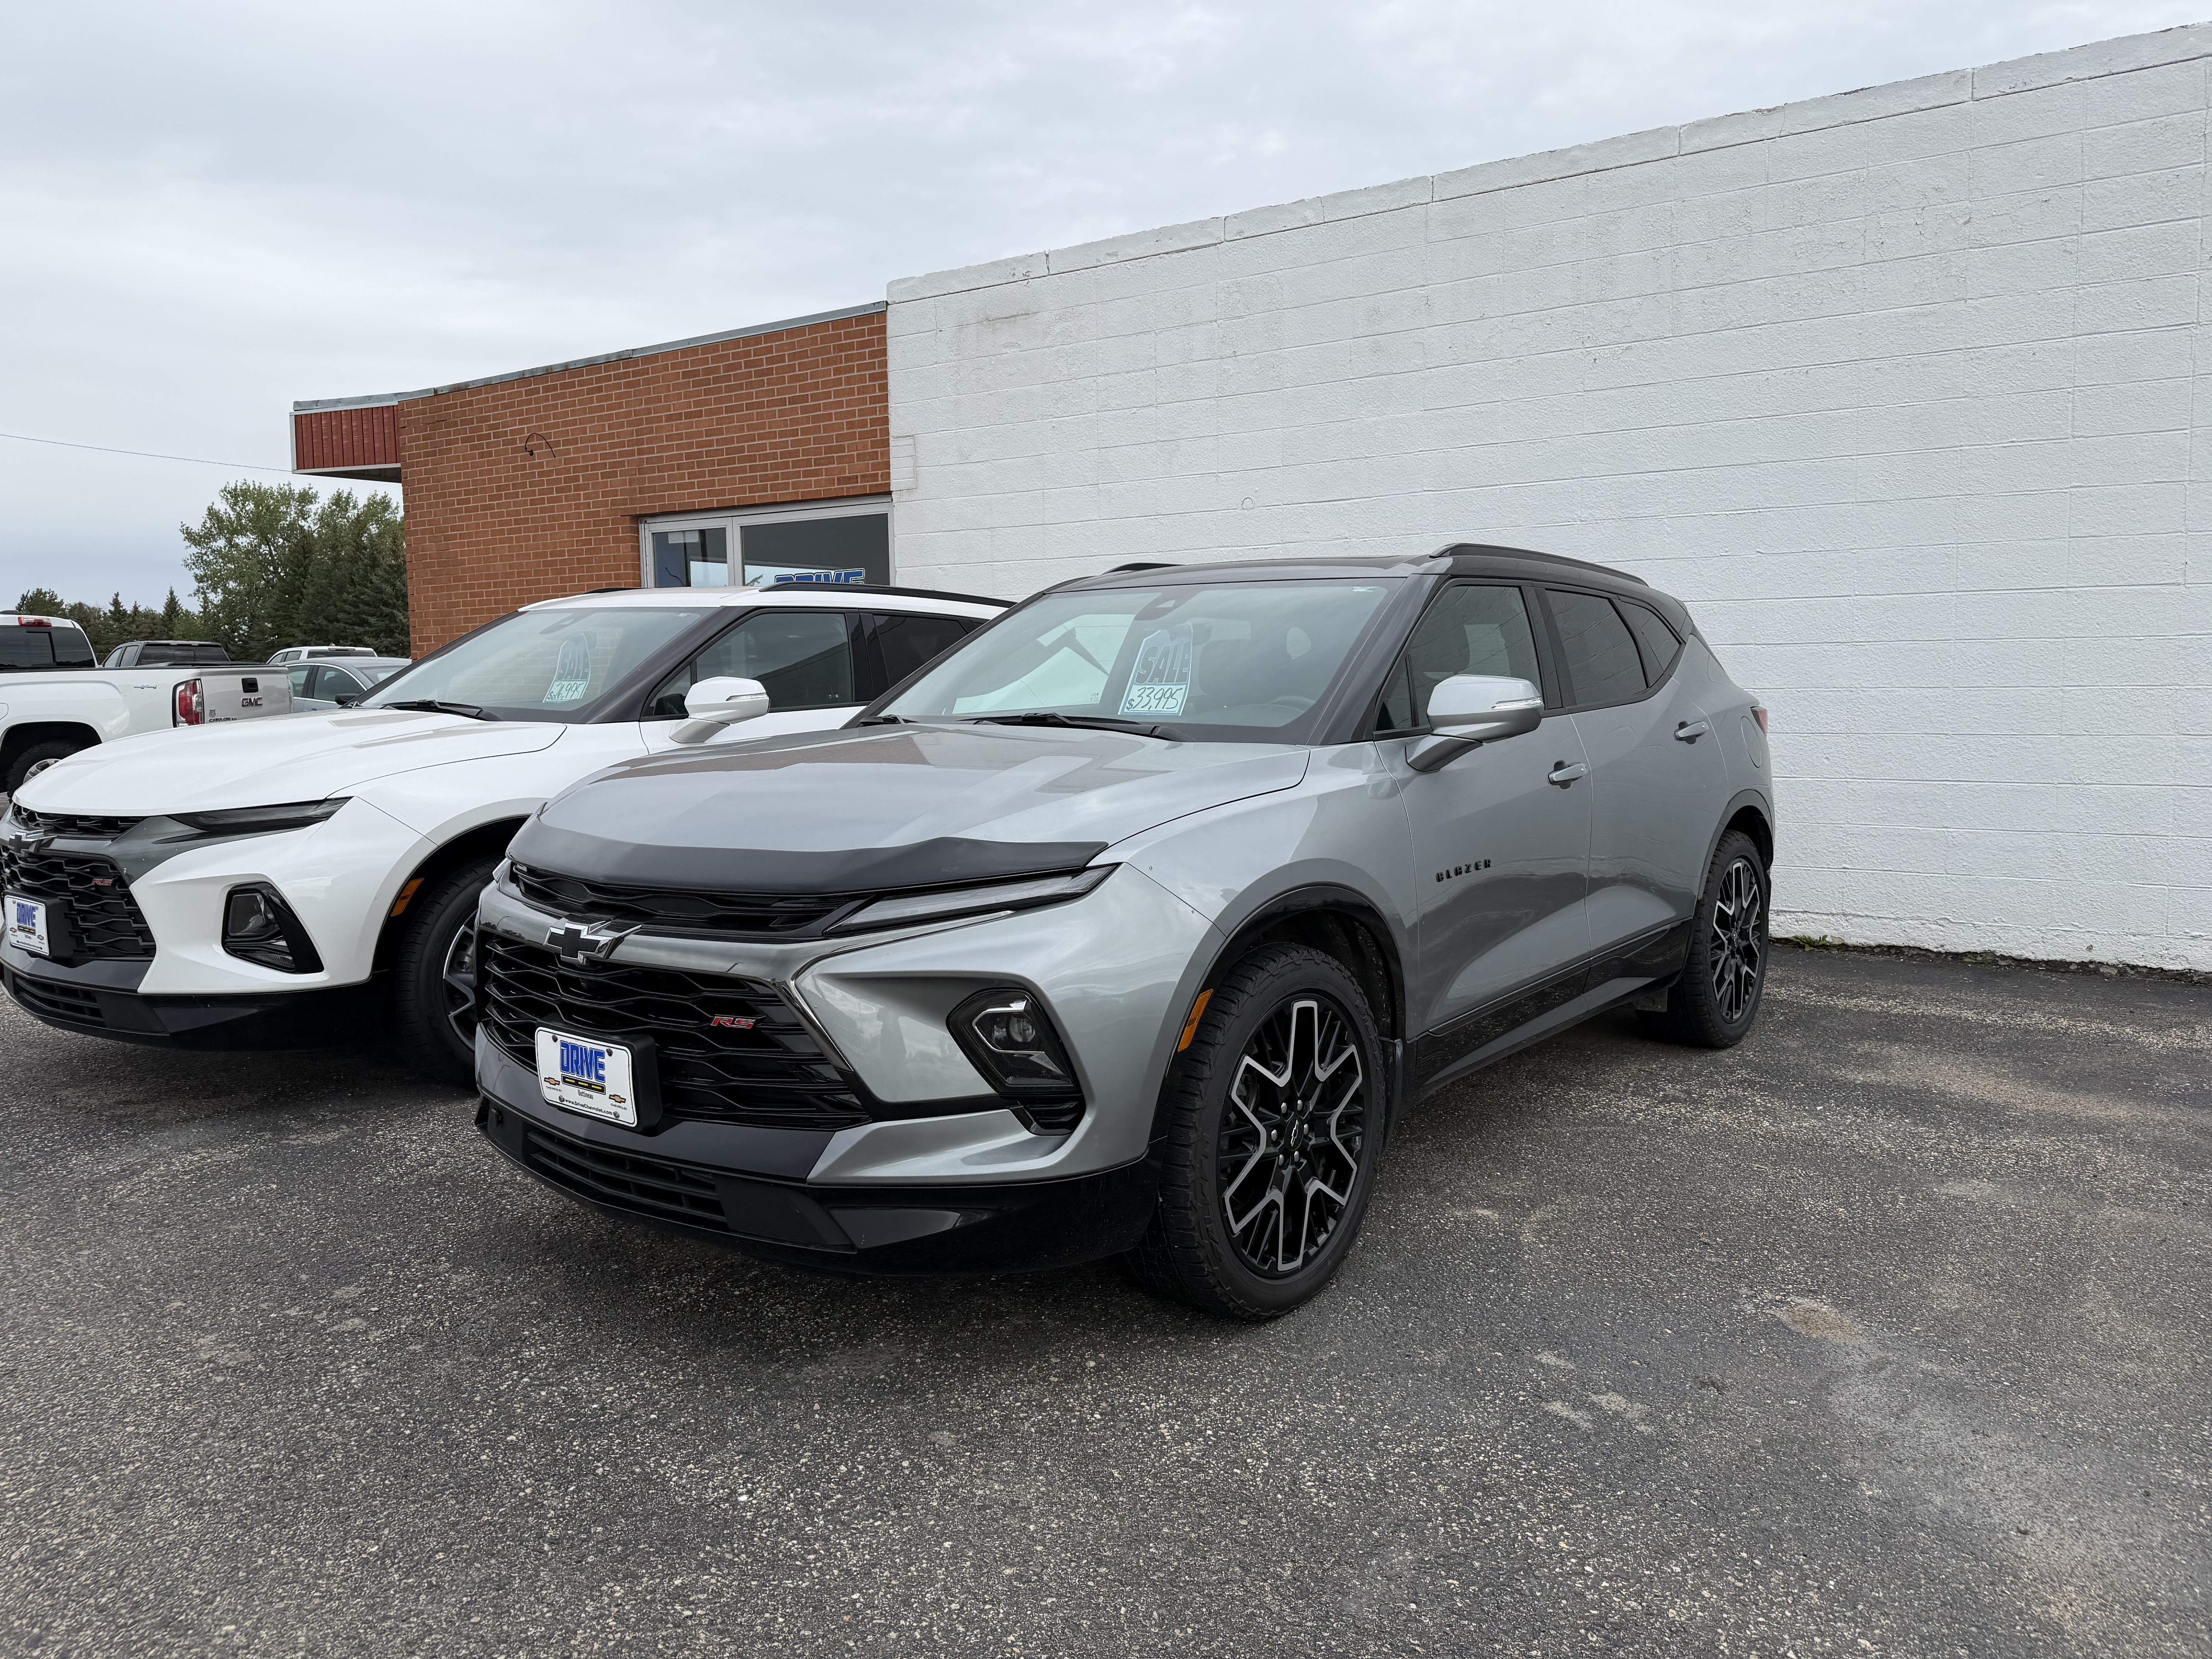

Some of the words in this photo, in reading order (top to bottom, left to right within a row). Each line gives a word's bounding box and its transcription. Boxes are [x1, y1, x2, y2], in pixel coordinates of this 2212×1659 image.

[556, 649, 589, 681] SALE
[1135, 640, 1192, 685] SALE
[242, 697, 263, 707] GMC
[1126, 687, 1183, 710] $33,995
[1435, 858, 1492, 883] BLAZER
[17, 902, 36, 928] DRIVE
[710, 1016, 756, 1029] RS
[560, 1040, 606, 1083] DRIVE
